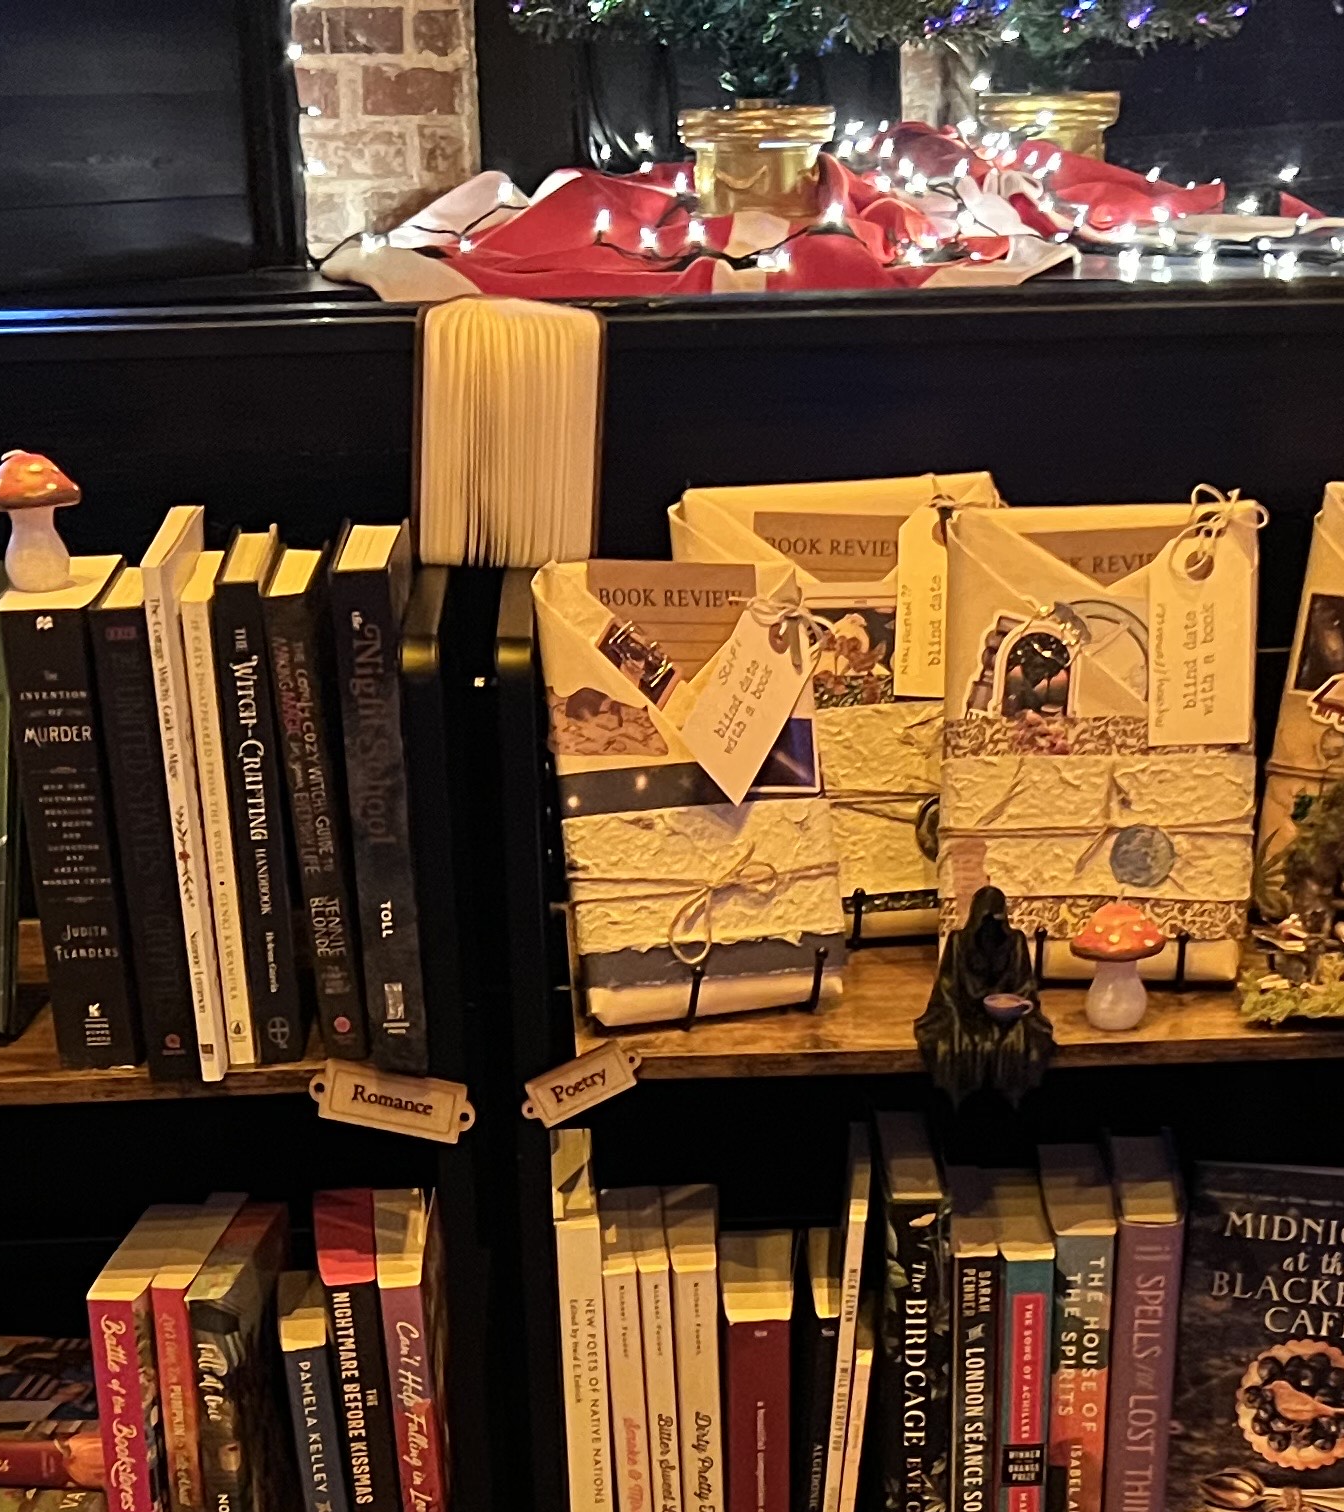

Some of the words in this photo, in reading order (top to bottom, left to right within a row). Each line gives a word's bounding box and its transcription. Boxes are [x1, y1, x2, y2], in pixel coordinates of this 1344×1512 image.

[762, 537, 822, 556] BOOK
[829, 538, 900, 558] REVIE
[599, 588, 657, 608] BOOK
[664, 589, 743, 607] REVIEW
[927, 574, 943, 612] date
[234, 628, 248, 652] THE
[927, 619, 942, 667] blind
[1182, 610, 1198, 650] date
[1182, 659, 1197, 709] blind
[24, 725, 93, 748] MURDER
[229, 655, 268, 841] WITCH-CRAFTING
[255, 847, 273, 916] HANDBOOK
[380, 900, 393, 939] TOLL
[351, 1084, 434, 1118] Romance
[548, 1067, 608, 1104] Poetry
[910, 1260, 928, 1294] The
[1087, 1257, 1105, 1302] THE
[1282, 1254, 1309, 1273] at
[584, 1297, 596, 1327] NEW
[1063, 1272, 1083, 1318] THE
[1132, 1274, 1167, 1361] SPELLS
[100, 1313, 128, 1374] Battle
[331, 1291, 361, 1379] NIGHTMARE
[586, 1332, 598, 1372] POETS
[1082, 1308, 1102, 1394] HOUSE
[110, 1378, 125, 1395] of
[588, 1376, 599, 1393] OF
[903, 1297, 928, 1447] BIRDCAGE
[964, 1346, 986, 1421] LONDON
[1058, 1331, 1080, 1417] SPIRITS
[343, 1383, 366, 1439] BEFORE
[365, 1388, 378, 1407] THE
[589, 1397, 602, 1443] NATIVE
[1083, 1401, 1099, 1434] OF
[694, 1411, 711, 1454] Dirty
[1127, 1391, 1160, 1453] LOST
[110, 1417, 136, 1512] Bookstores
[348, 1441, 374, 1505] KISSMAS
[592, 1446, 606, 1504] NATIONS
[906, 1456, 922, 1488] EVE
[963, 1422, 985, 1488] SÉANCE
[1066, 1443, 1083, 1496] ISABEL
[695, 1457, 713, 1504] Pretty
